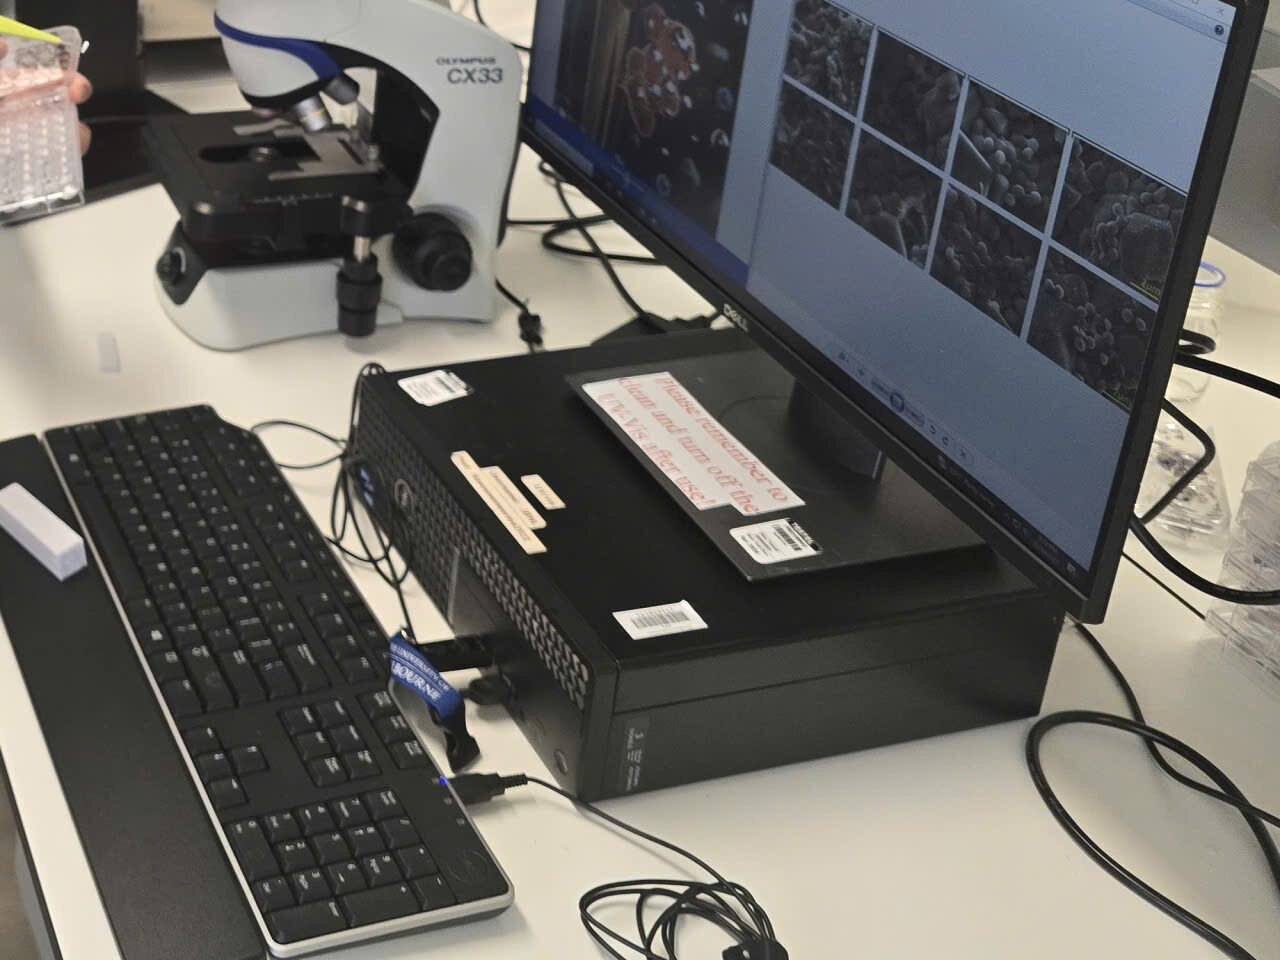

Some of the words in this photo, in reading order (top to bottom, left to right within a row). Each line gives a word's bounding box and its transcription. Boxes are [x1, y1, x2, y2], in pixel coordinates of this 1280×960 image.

[436, 56, 496, 66] OLYMPUS
[447, 68, 503, 84] CX33
[724, 303, 748, 332] DELL
[696, 416, 769, 484] remember
[768, 480, 788, 503] to
[707, 463, 743, 488] off
[730, 486, 761, 513] the
